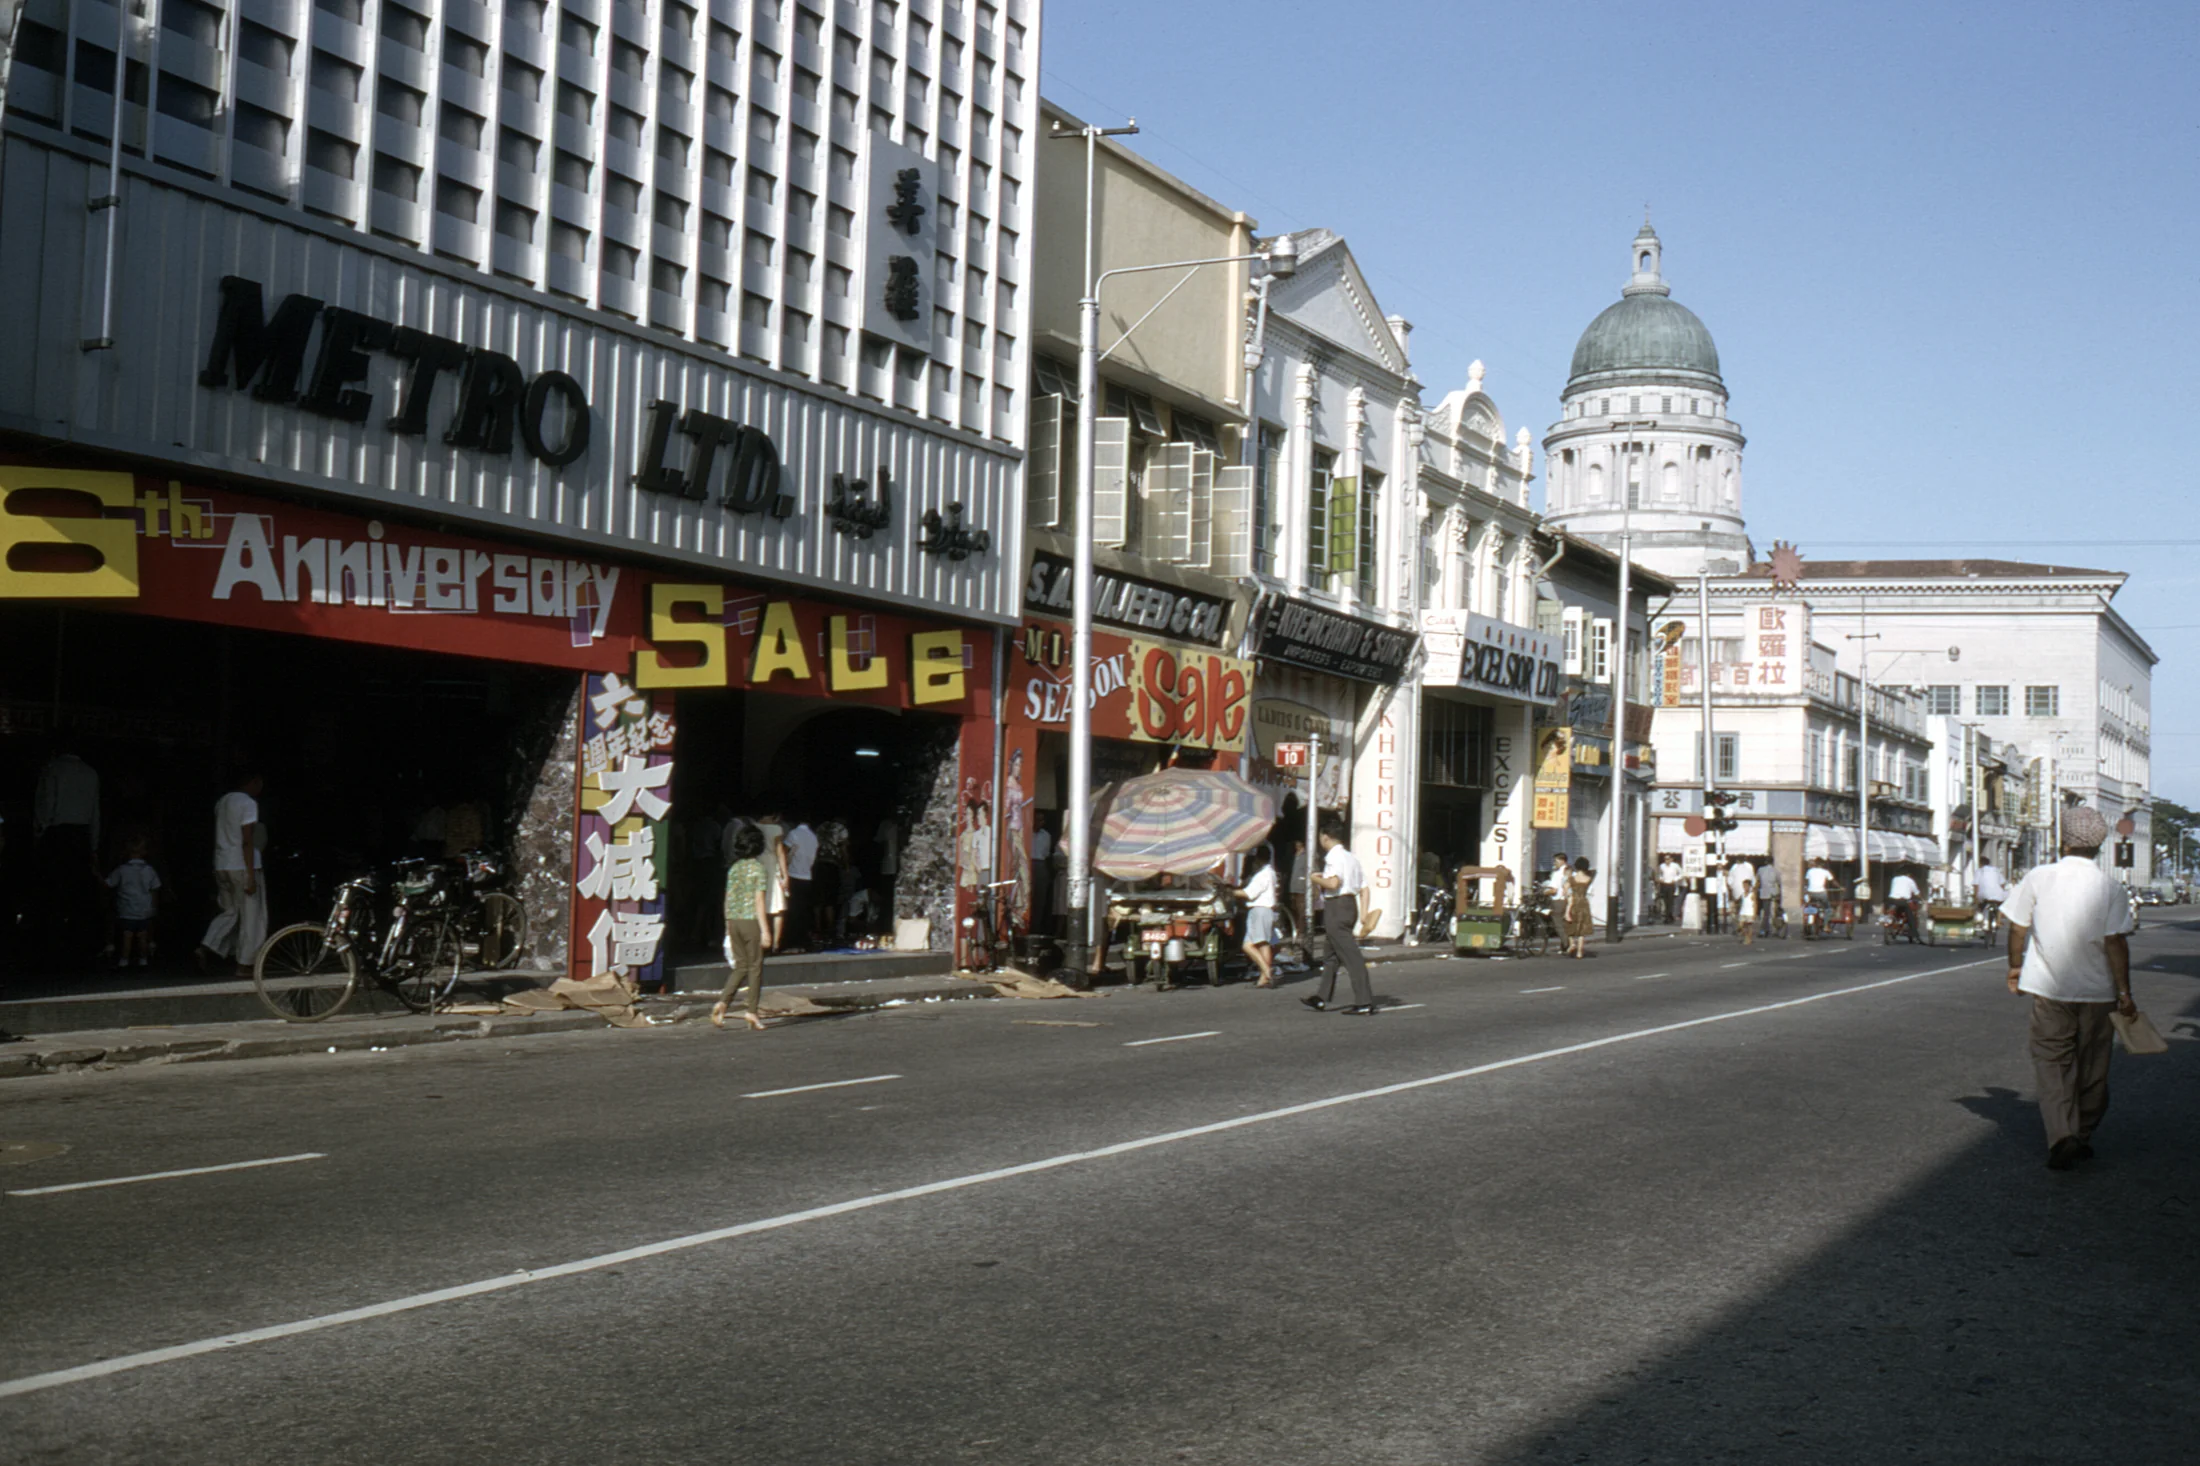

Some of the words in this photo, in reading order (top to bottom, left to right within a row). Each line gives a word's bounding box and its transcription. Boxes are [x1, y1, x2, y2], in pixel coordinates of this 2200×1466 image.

[199, 275, 591, 466] METRO
[631, 399, 795, 519] LTD.
[212, 512, 621, 638] Anniversary
[636, 583, 966, 705] SALE
[1276, 602, 1364, 656] KHEMCHAND
[1025, 628, 1073, 669] MI
[1460, 637, 1534, 697] EXCELSIOR
[591, 672, 646, 729] 六
[1024, 653, 1127, 723] SEAON
[1138, 647, 1246, 747] Sale
[1284, 752, 1298, 765] 10
